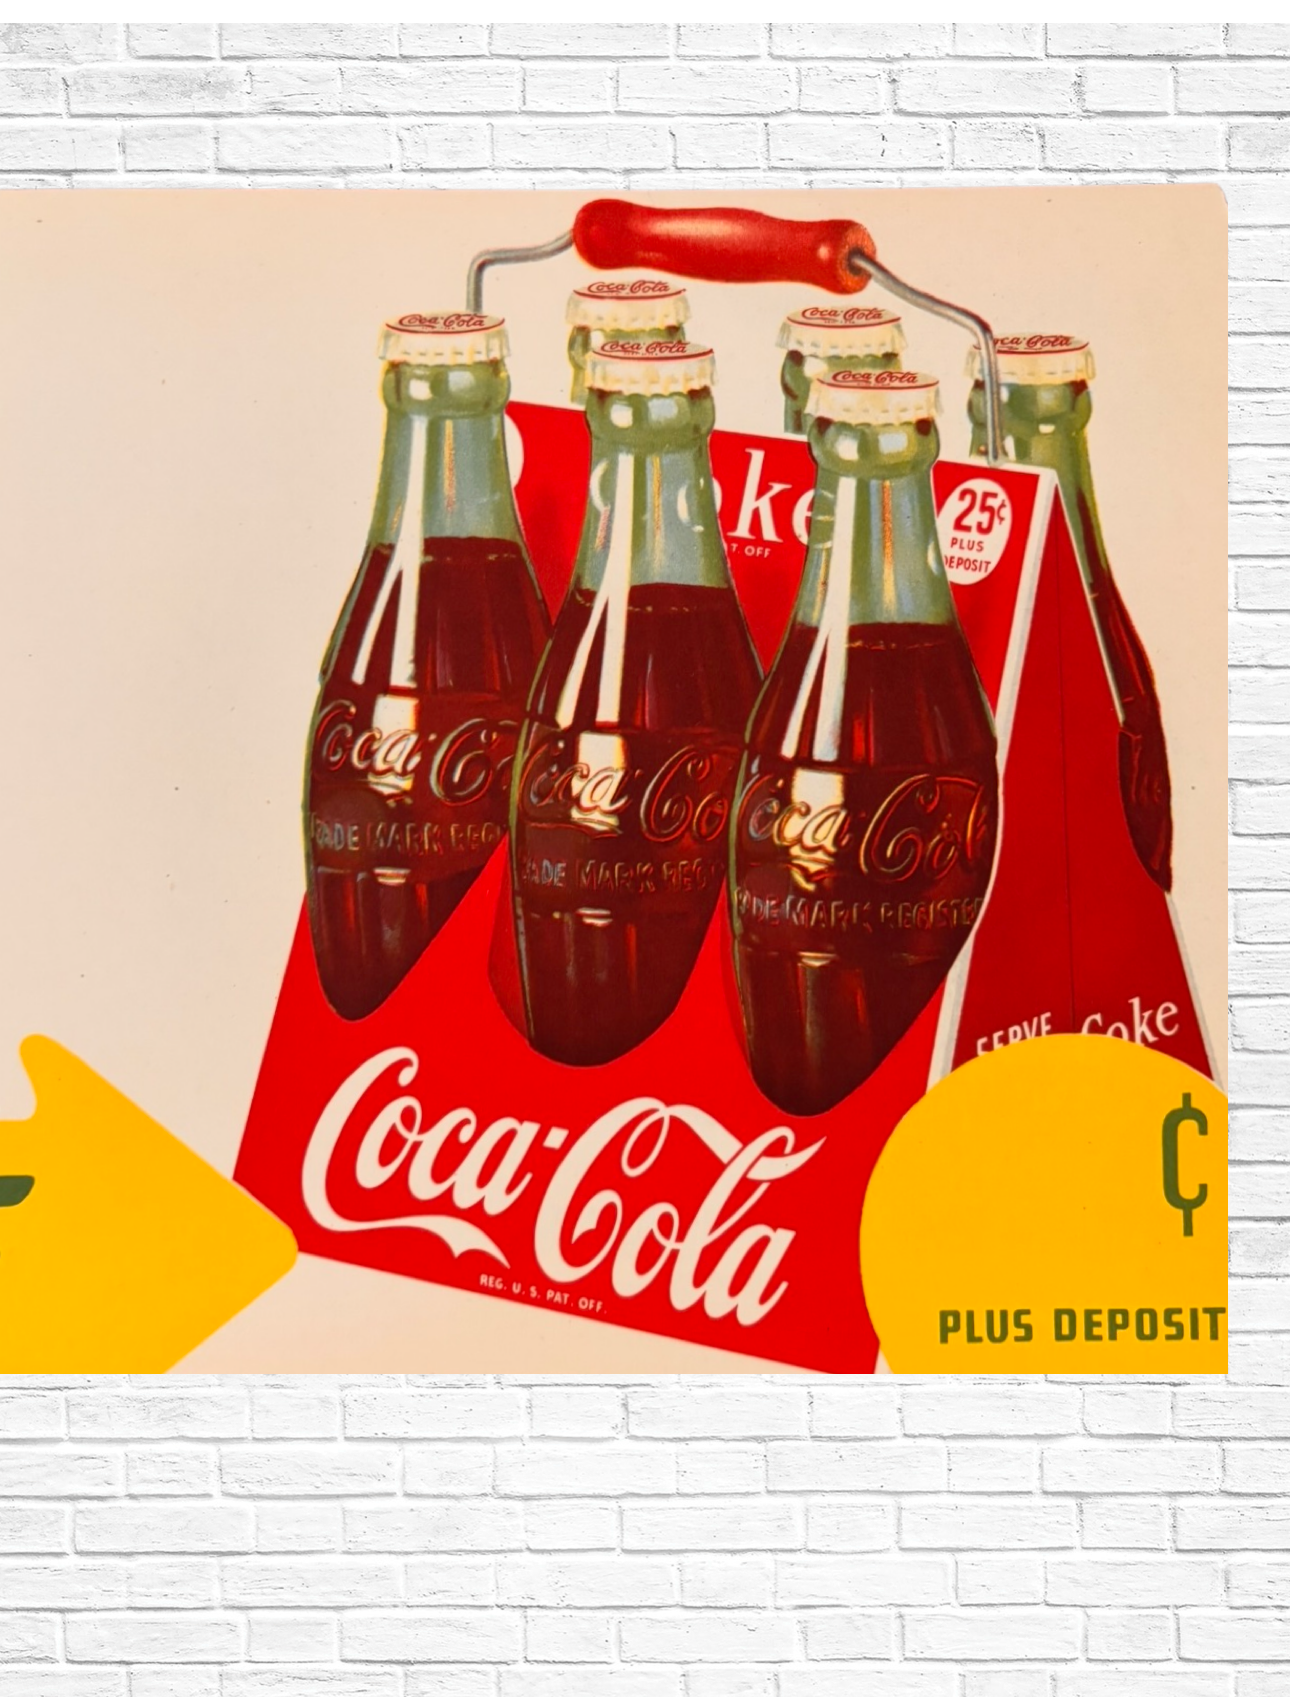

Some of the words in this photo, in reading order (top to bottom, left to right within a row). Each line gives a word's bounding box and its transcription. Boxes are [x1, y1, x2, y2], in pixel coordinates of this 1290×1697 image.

[953, 487, 1007, 536] 25¢
[950, 537, 984, 552] PLUS
[302, 1046, 827, 1326] Coca-Cola
[480, 1273, 507, 1290] REG.
[546, 1288, 573, 1307] PAT.
[939, 1310, 1033, 1344] PLUS
[1054, 1306, 1227, 1342] DEPOSIT
